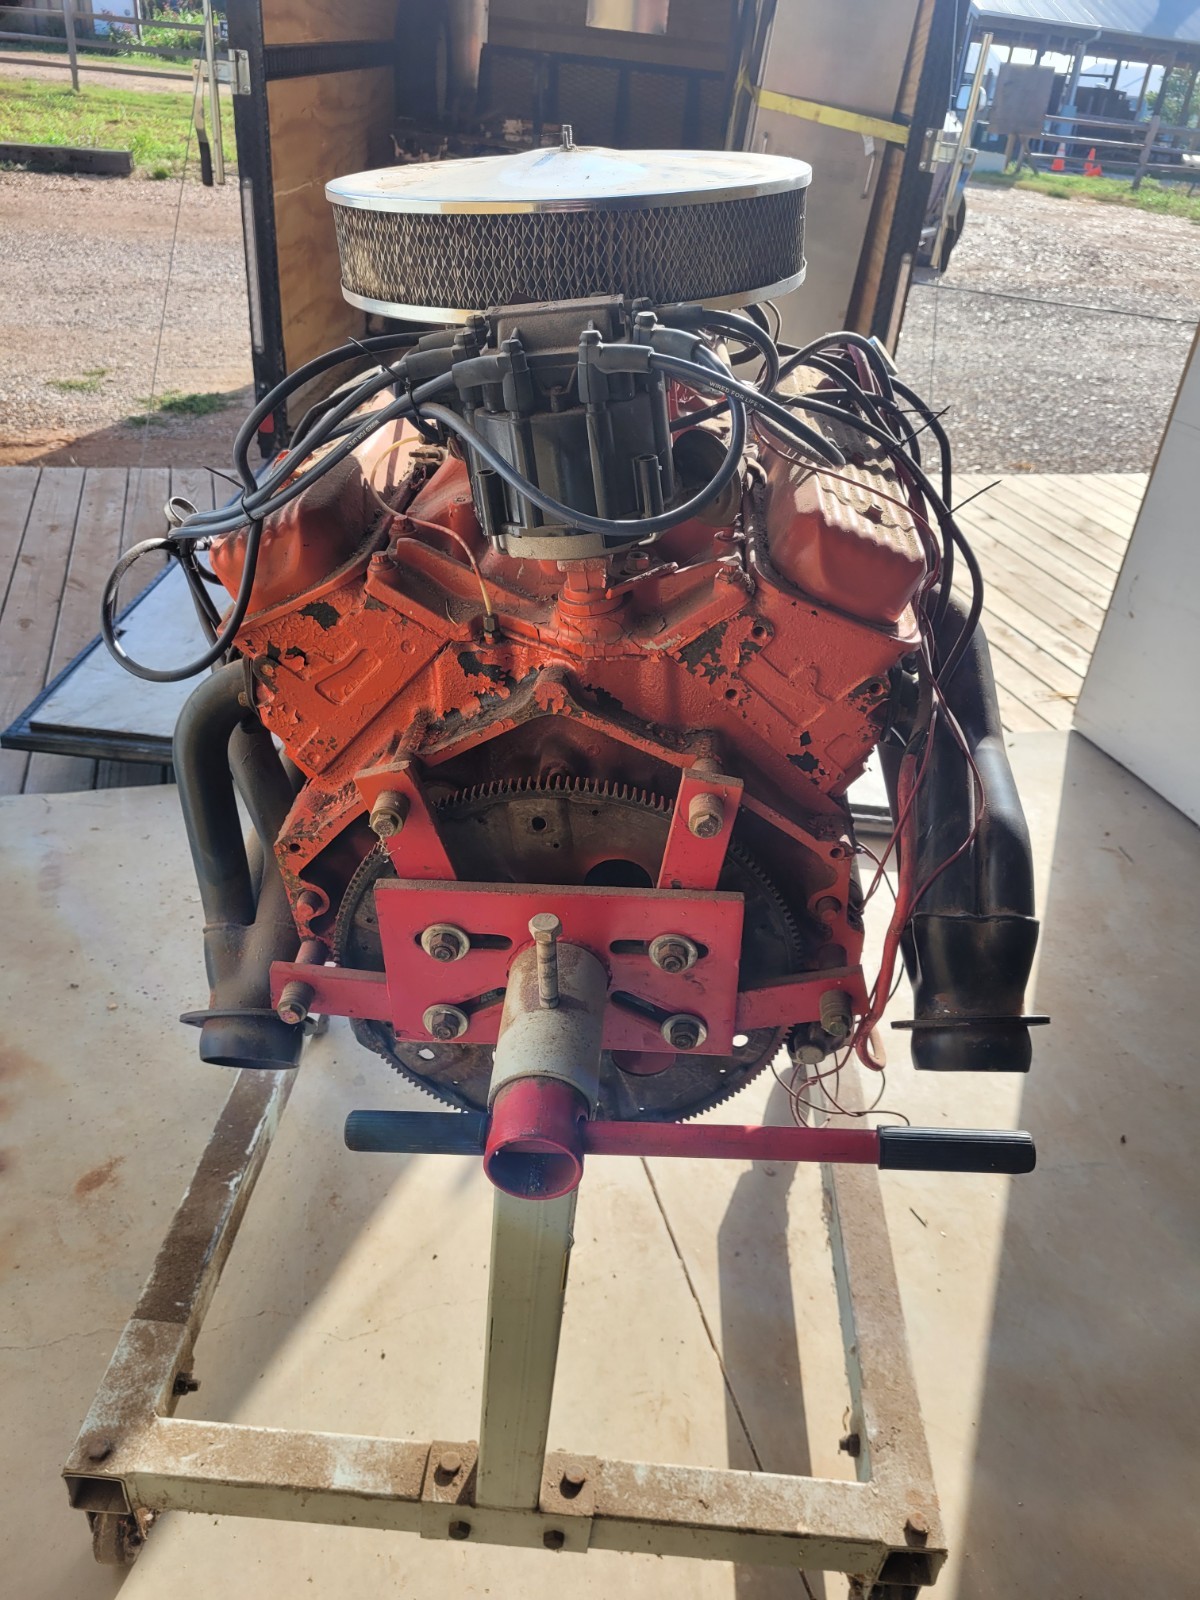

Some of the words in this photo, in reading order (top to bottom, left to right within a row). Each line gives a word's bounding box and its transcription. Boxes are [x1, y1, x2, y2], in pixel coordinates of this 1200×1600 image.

[709, 381, 730, 393] WIRED
[730, 390, 745, 400] FOR
[357, 429, 367, 439] FOR
